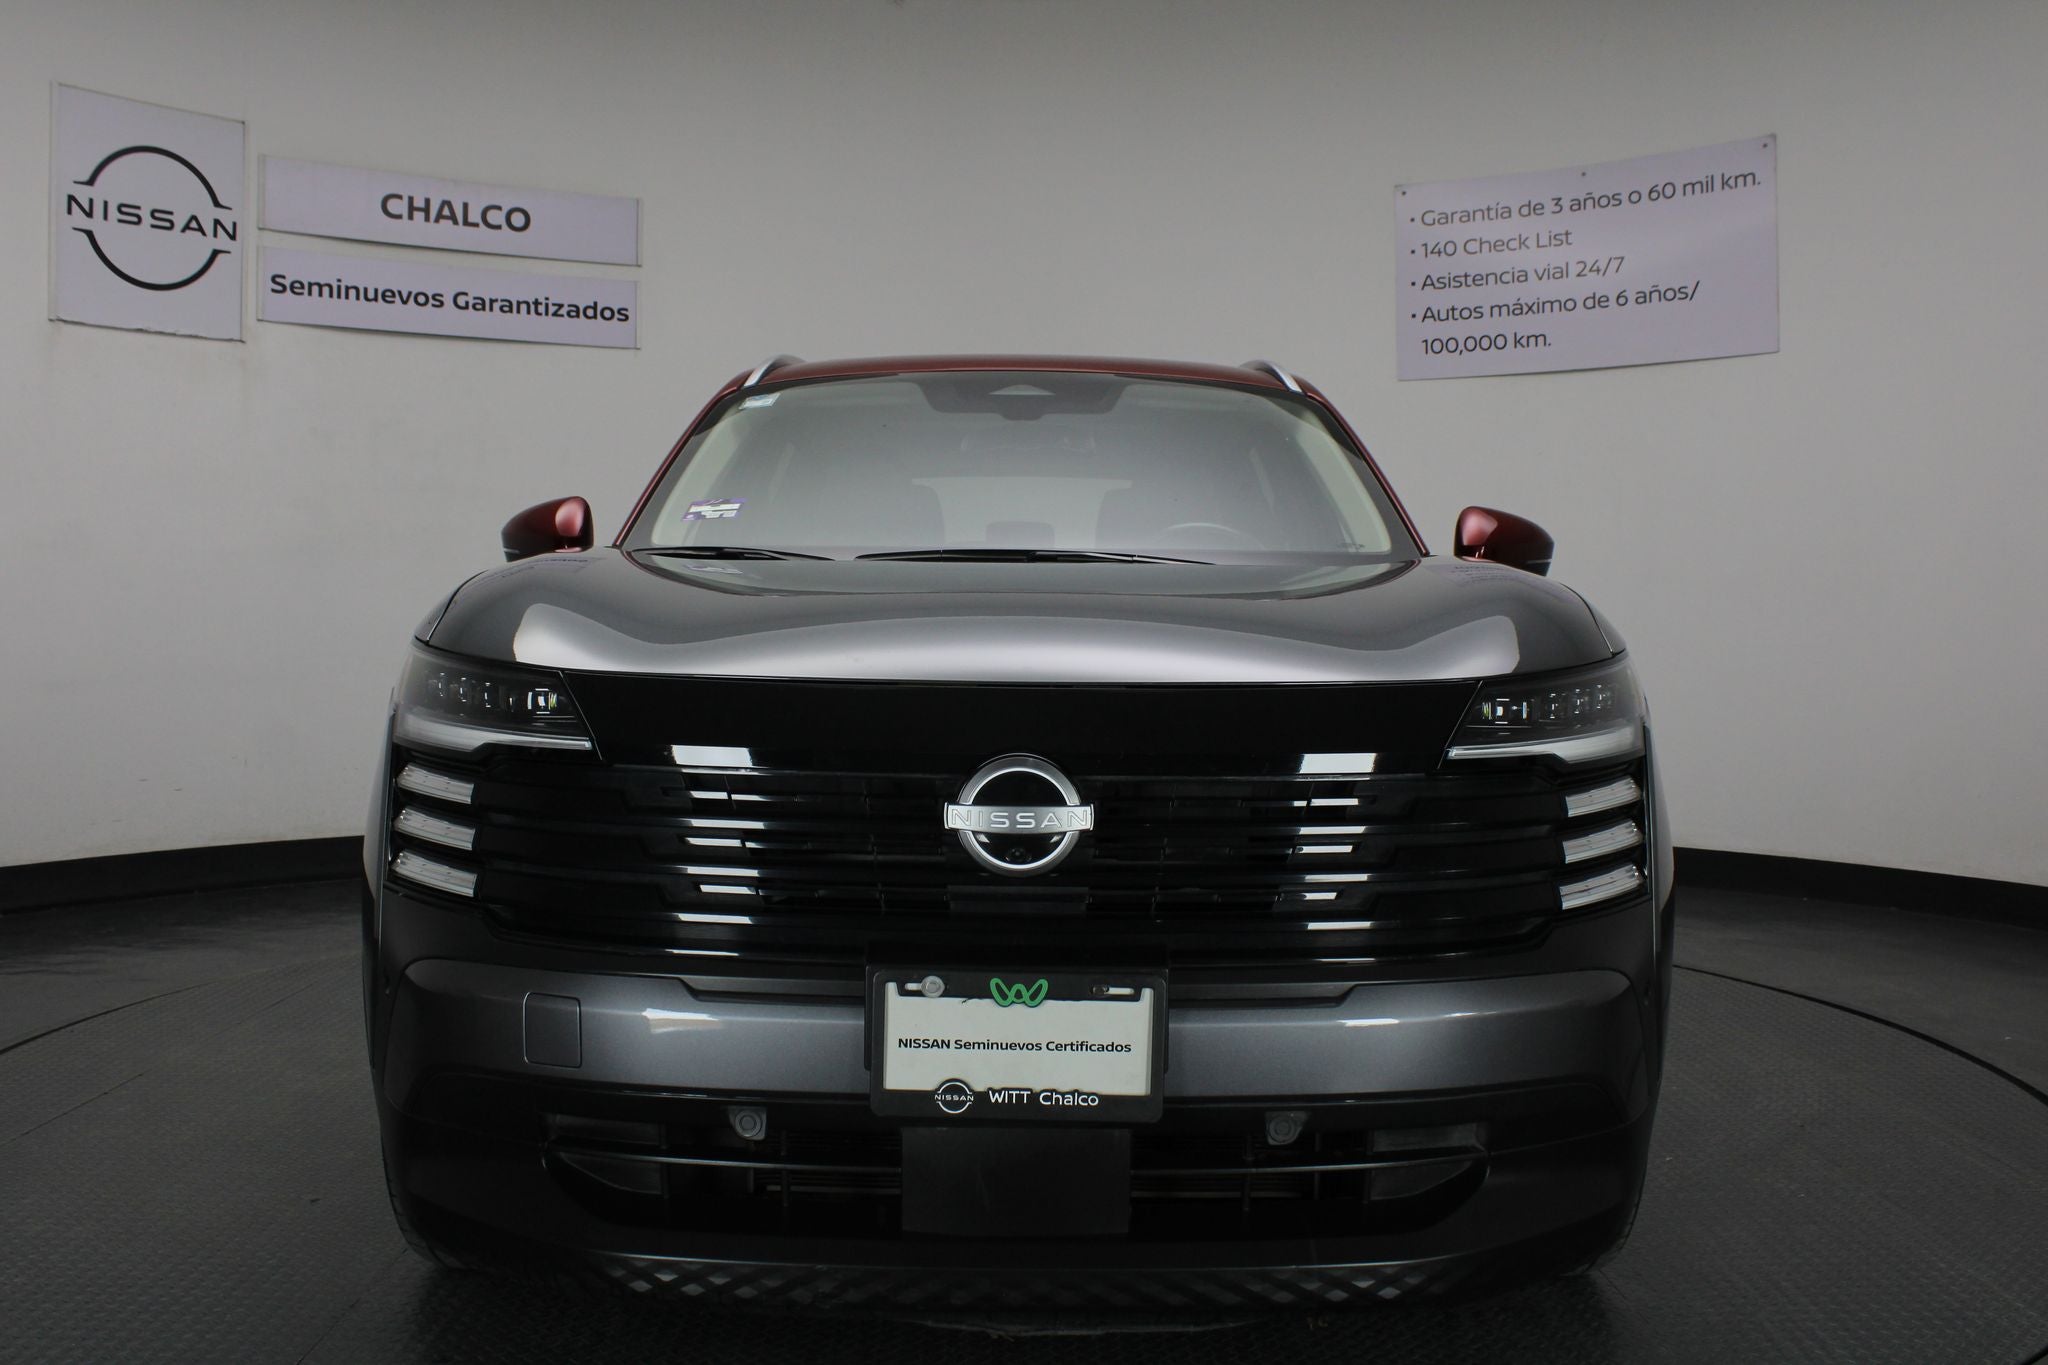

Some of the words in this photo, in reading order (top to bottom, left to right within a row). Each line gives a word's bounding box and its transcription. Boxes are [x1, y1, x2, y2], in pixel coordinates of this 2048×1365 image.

[379, 192, 531, 233] CHALCO
[1421, 202, 1512, 227] Garantía
[1518, 199, 1545, 217] de
[1551, 197, 1563, 215] 3
[1569, 192, 1622, 213] años
[1628, 189, 1641, 204] o
[1648, 182, 1676, 201] 60
[1682, 174, 1715, 197] mil
[1720, 169, 1761, 190] km.
[66, 194, 237, 242] NISSAN
[1422, 241, 1457, 259] 140
[1463, 233, 1530, 256] Check
[1536, 229, 1573, 247] List
[1421, 270, 1529, 291] Asistencia
[1534, 262, 1569, 281] vial
[1575, 256, 1625, 279] 24/7
[270, 273, 445, 310] Seminuevos
[452, 290, 630, 323] Garantizados
[1421, 303, 1484, 323] Autos
[1489, 298, 1577, 318] máximo
[1583, 292, 1610, 309] de
[1616, 290, 1628, 307] 6
[1634, 280, 1700, 303] años/
[1422, 335, 1507, 356] 100,000
[1513, 331, 1552, 350] km.
[951, 809, 1088, 828] NISSAN
[898, 1038, 951, 1049] NISSAN
[954, 1039, 1042, 1051] Seminuevos
[1045, 1040, 1132, 1053] Certificados
[989, 1090, 1031, 1104] WITT
[1039, 1092, 1099, 1106] Chalco
